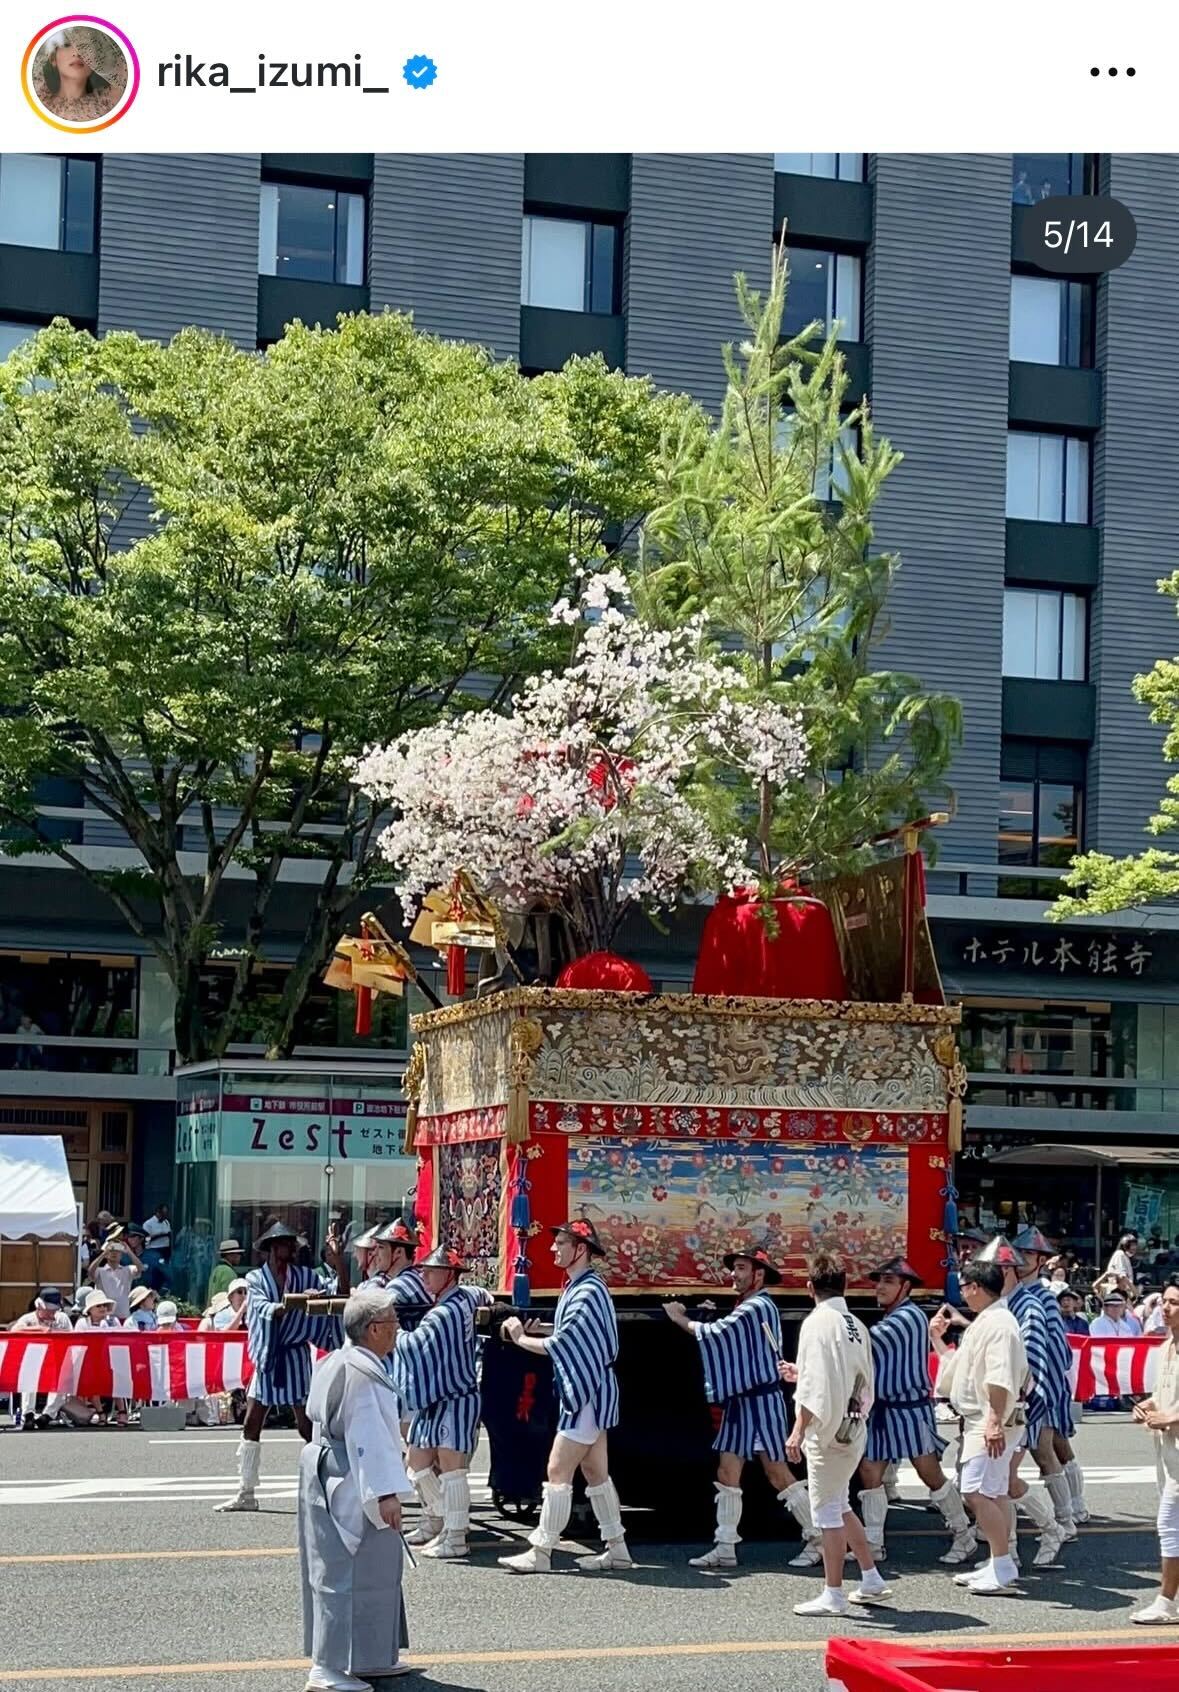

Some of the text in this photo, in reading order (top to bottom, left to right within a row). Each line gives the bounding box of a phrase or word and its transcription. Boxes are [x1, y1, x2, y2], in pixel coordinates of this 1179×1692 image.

[963, 937, 1152, 975] ホテル本能寺
[251, 1118, 352, 1159] Zest
